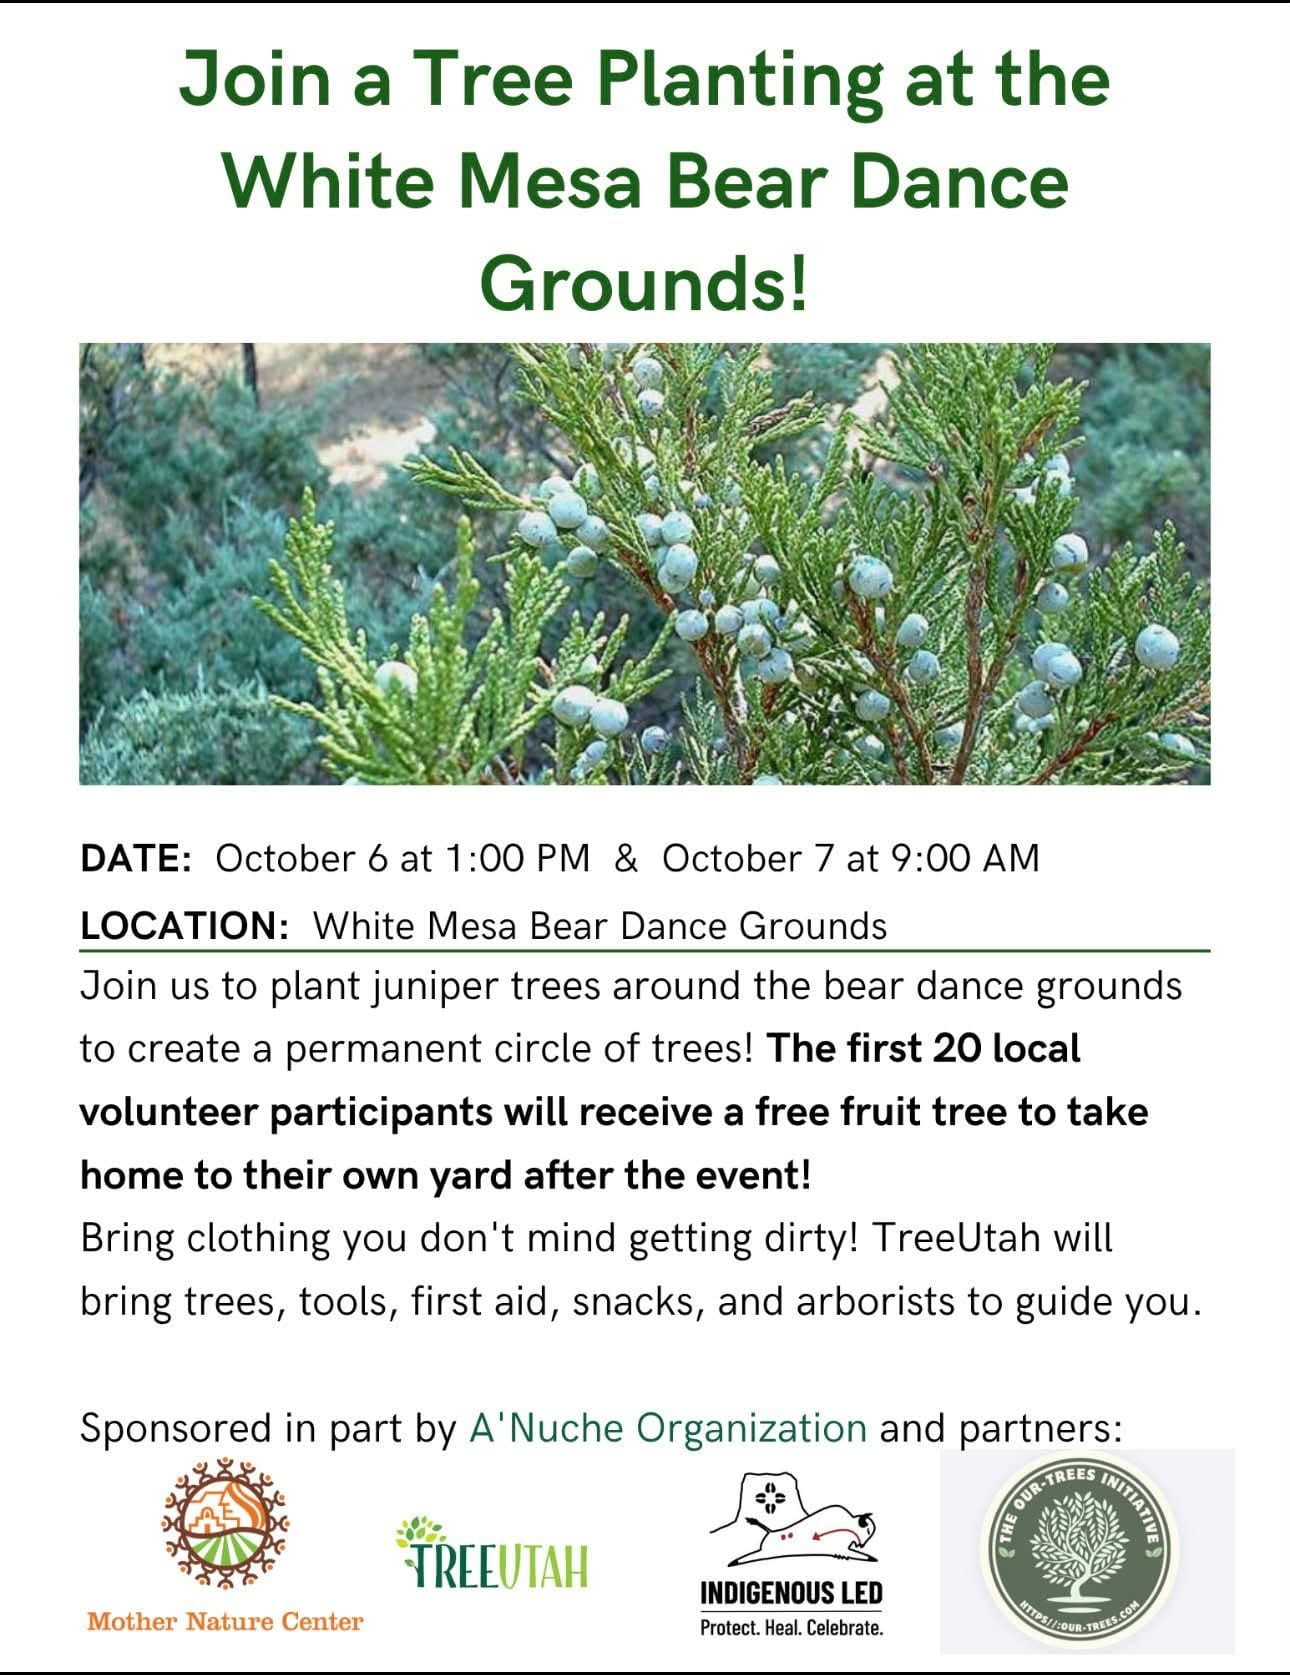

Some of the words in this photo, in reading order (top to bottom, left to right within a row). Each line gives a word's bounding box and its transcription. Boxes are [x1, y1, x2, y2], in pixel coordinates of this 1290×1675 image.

[179, 49, 329, 106] Join
[354, 65, 390, 106] a
[413, 49, 572, 106] Tree
[600, 49, 884, 124] Planting
[907, 50, 973, 106] at
[995, 49, 1109, 106] the
[221, 152, 433, 208] White
[462, 152, 640, 208] Mesa
[670, 152, 828, 208] Bear
[854, 152, 1068, 208] Dance
[481, 254, 804, 311] Grounds!
[82, 844, 190, 872] DATE:
[217, 843, 356, 872] October
[369, 843, 388, 872] 6
[401, 845, 432, 872] at
[447, 843, 524, 872] 1:00
[539, 844, 588, 872] PM
[615, 843, 638, 872] &
[664, 843, 802, 872] October
[815, 844, 834, 872] 7
[848, 845, 879, 872] at
[892, 843, 970, 872] 9:00
[983, 844, 1038, 872] AM
[82, 911, 287, 940] LOCATION:
[313, 911, 414, 940] White
[430, 911, 515, 940] Mesa
[532, 911, 608, 940] Bear
[623, 911, 726, 939] Dance
[740, 911, 886, 940] Grounds
[80, 970, 155, 1000] Join
[172, 978, 209, 1000] us
[222, 972, 256, 1000] to
[273, 970, 360, 1008] plant
[371, 970, 499, 1008] juniper
[511, 972, 600, 1000] trees
[614, 970, 739, 1000] around
[754, 970, 810, 1000] the
[826, 970, 904, 1000] bear
[917, 970, 1023, 1000] dance
[1038, 970, 1182, 1009] grounds
[80, 1034, 114, 1062] to
[129, 1034, 240, 1062] create
[254, 1041, 271, 1063] a
[288, 1034, 482, 1071] permanent
[495, 1032, 591, 1063] circle
[605, 1032, 640, 1062] of
[652, 1032, 751, 1063] trees!
[766, 1032, 836, 1062] The
[847, 1032, 922, 1062] first
[933, 1032, 981, 1062] 20
[994, 1032, 1081, 1062] local
[79, 1096, 259, 1126] volunteer
[272, 1096, 492, 1135] participants
[504, 1096, 568, 1126] will
[581, 1096, 712, 1126] receive
[724, 1104, 743, 1126] a
[755, 1096, 829, 1126] free
[840, 1096, 920, 1126] fruit
[932, 1096, 1007, 1126] tree
[1018, 1096, 1056, 1126] to
[1067, 1096, 1148, 1126] take
[82, 1159, 183, 1189] home
[194, 1160, 232, 1189] to
[243, 1159, 332, 1189] their
[343, 1168, 418, 1189] own
[430, 1159, 511, 1198] yard
[525, 1159, 614, 1189] after
[624, 1159, 685, 1189] the
[697, 1159, 809, 1189] event!
[83, 1222, 174, 1261] Bring
[188, 1222, 330, 1261] clothing
[343, 1230, 405, 1260] you
[421, 1221, 514, 1252] don't
[529, 1222, 614, 1252] mind
[630, 1222, 752, 1261] getting
[766, 1222, 856, 1260] dirty!
[872, 1222, 1039, 1252] TreeUtah
[1054, 1222, 1112, 1252] will
[82, 1285, 172, 1324] bring
[185, 1287, 284, 1322] trees,
[299, 1285, 397, 1321] tools,
[411, 1285, 482, 1315] first
[496, 1285, 558, 1322] aid,
[574, 1285, 703, 1322] snacks,
[719, 1285, 782, 1315] and
[797, 1285, 954, 1315] arborists
[968, 1287, 1002, 1315] to
[1017, 1285, 1112, 1324] guide
[1125, 1294, 1200, 1324] you.
[81, 1412, 270, 1451] Sponsored
[287, 1412, 314, 1442] in
[331, 1414, 402, 1451] part
[417, 1412, 456, 1451] by
[470, 1412, 623, 1442] A'Nuche
[638, 1412, 865, 1451] Organization
[881, 1412, 944, 1442] and
[961, 1414, 1120, 1451] partners:
[1000, 1514, 1017, 1543] THE
[1013, 1468, 1095, 1510] OUR-TREES
[1101, 1473, 1159, 1543] INITIATIVE
[410, 1543, 589, 1589] TREEUTAH
[701, 1581, 834, 1604] INDIGENOUS
[842, 1581, 882, 1604] LED
[88, 1612, 177, 1630] Mother
[186, 1612, 273, 1631] Nature
[282, 1612, 364, 1631] Center
[701, 1619, 760, 1635] Protect.
[766, 1619, 802, 1635] Heal.
[807, 1619, 883, 1636] Celebrate.
